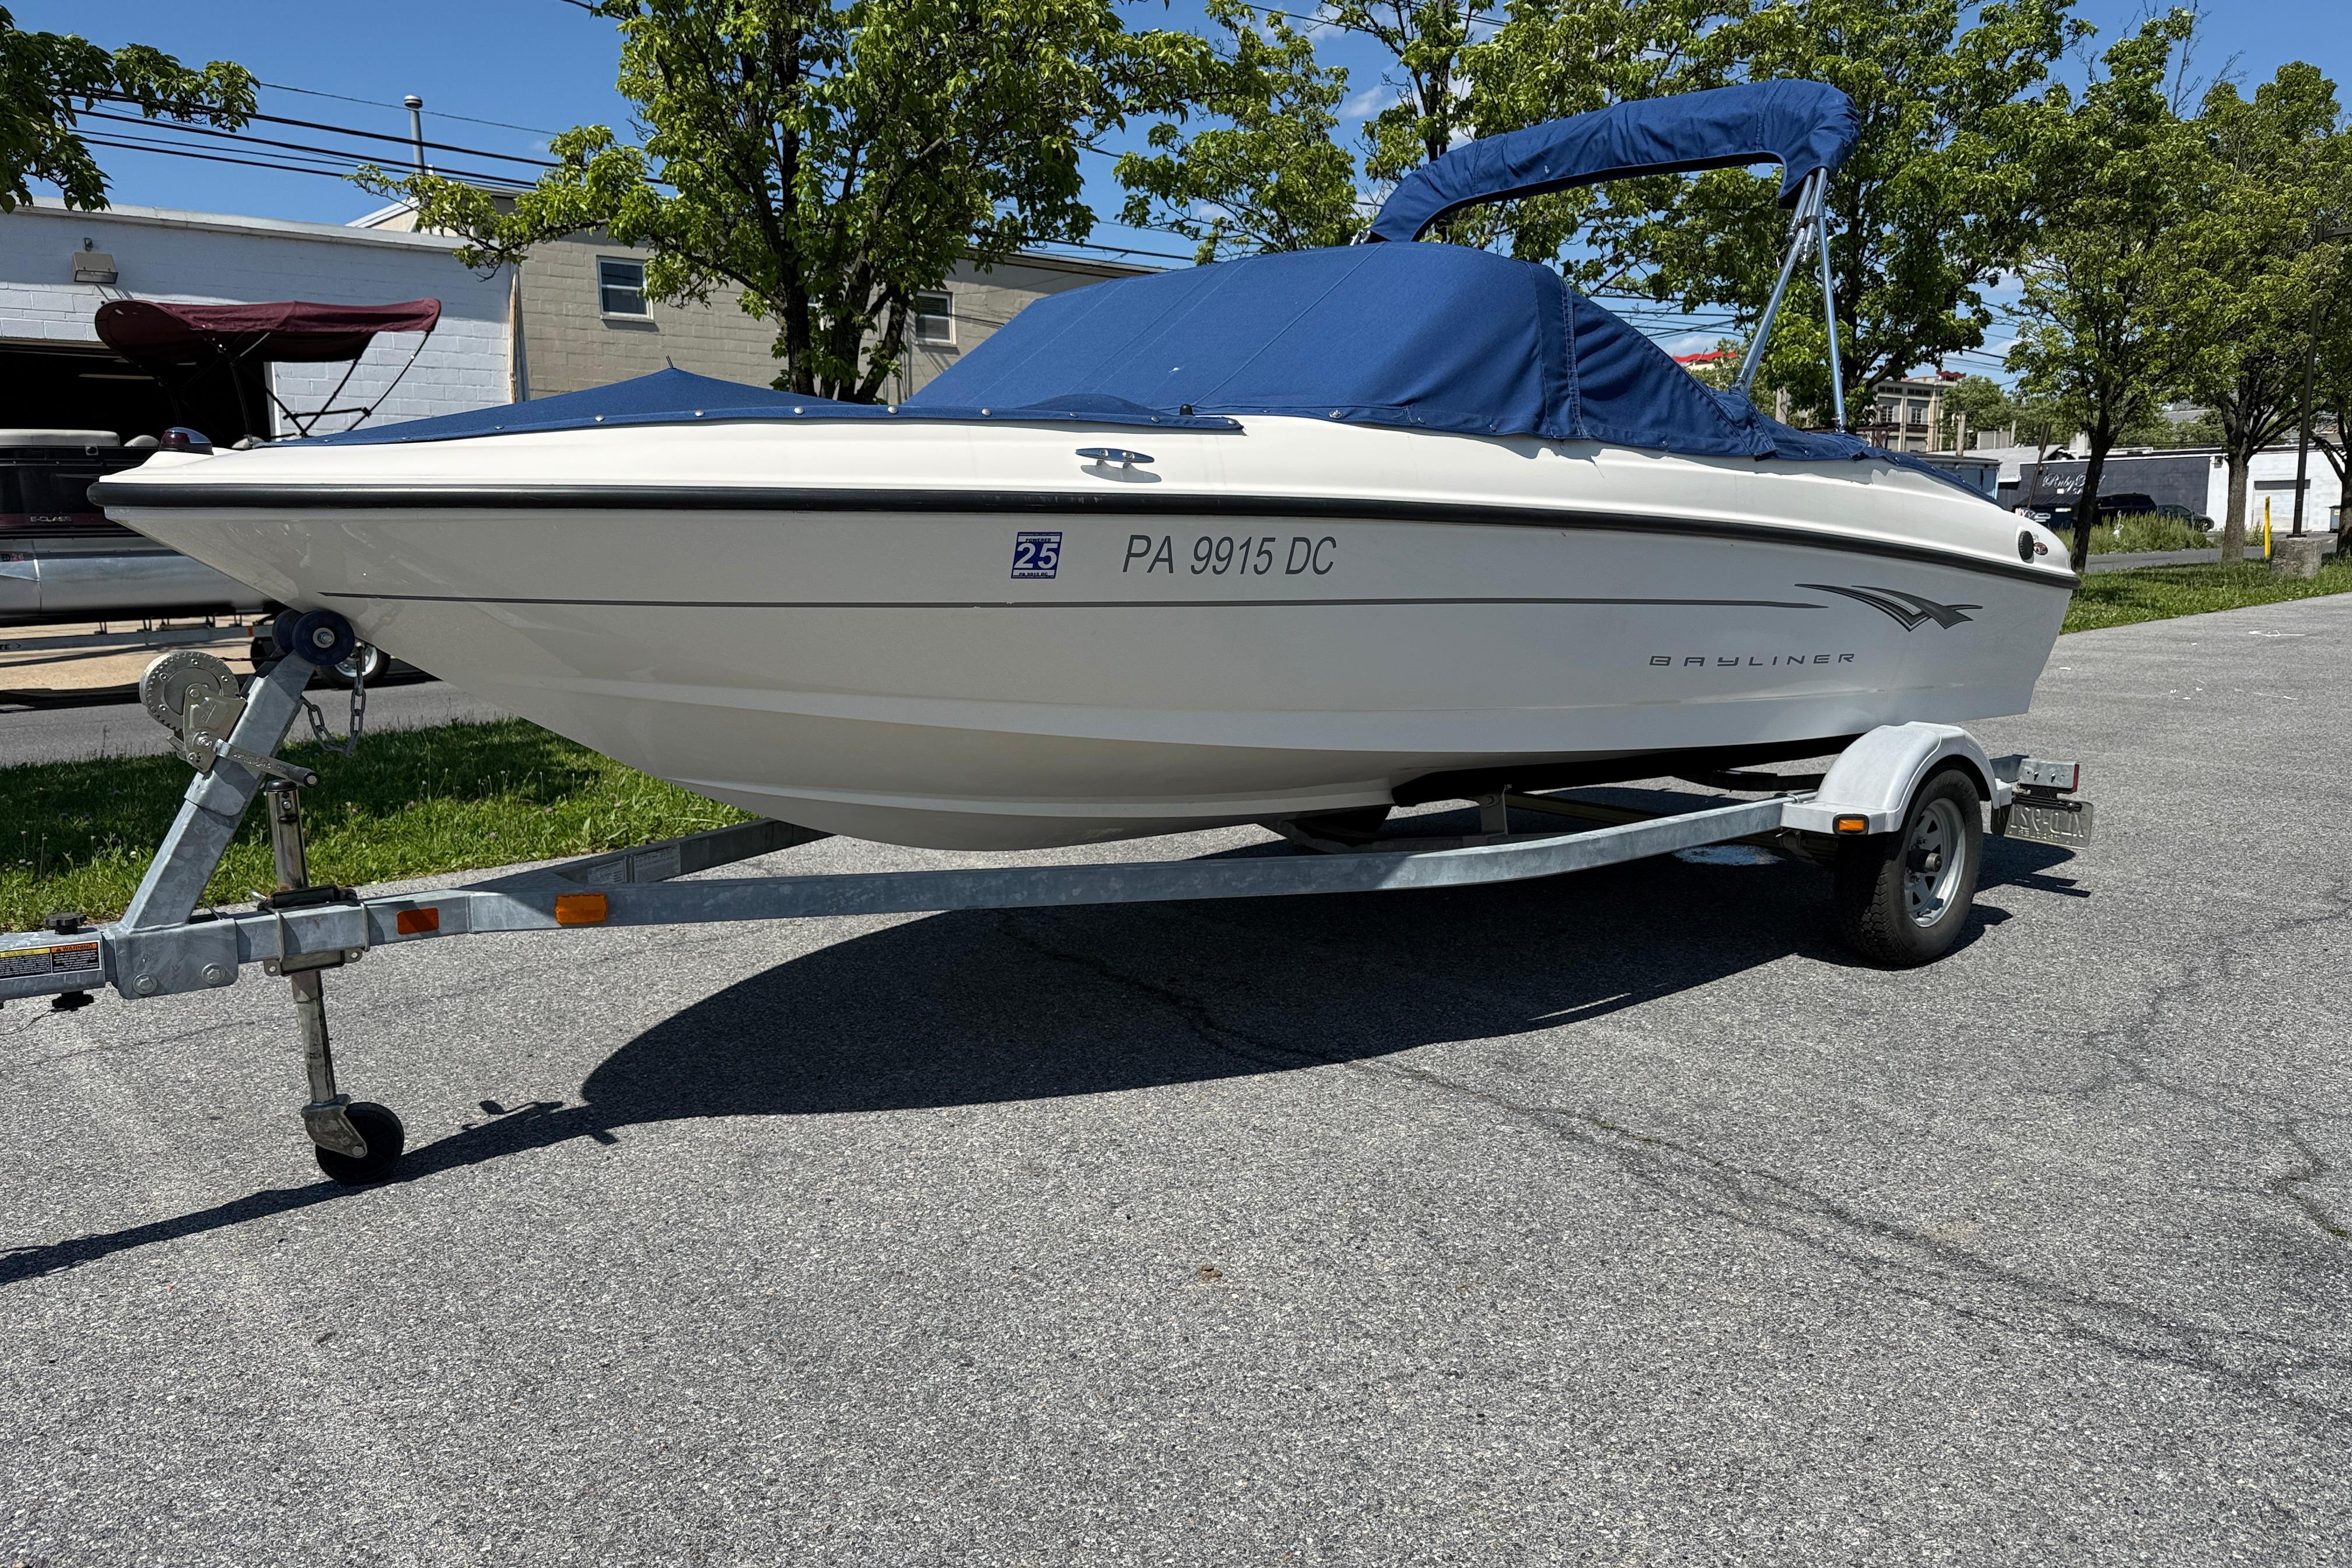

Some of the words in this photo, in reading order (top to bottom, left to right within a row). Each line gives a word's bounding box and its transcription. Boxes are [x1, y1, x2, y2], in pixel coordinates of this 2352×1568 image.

[1013, 542, 1058, 569] 25
[1122, 534, 1174, 573] PA
[1191, 536, 1276, 575] 9915
[1285, 536, 1336, 575] DC
[1649, 653, 1854, 667] BAYLINER
